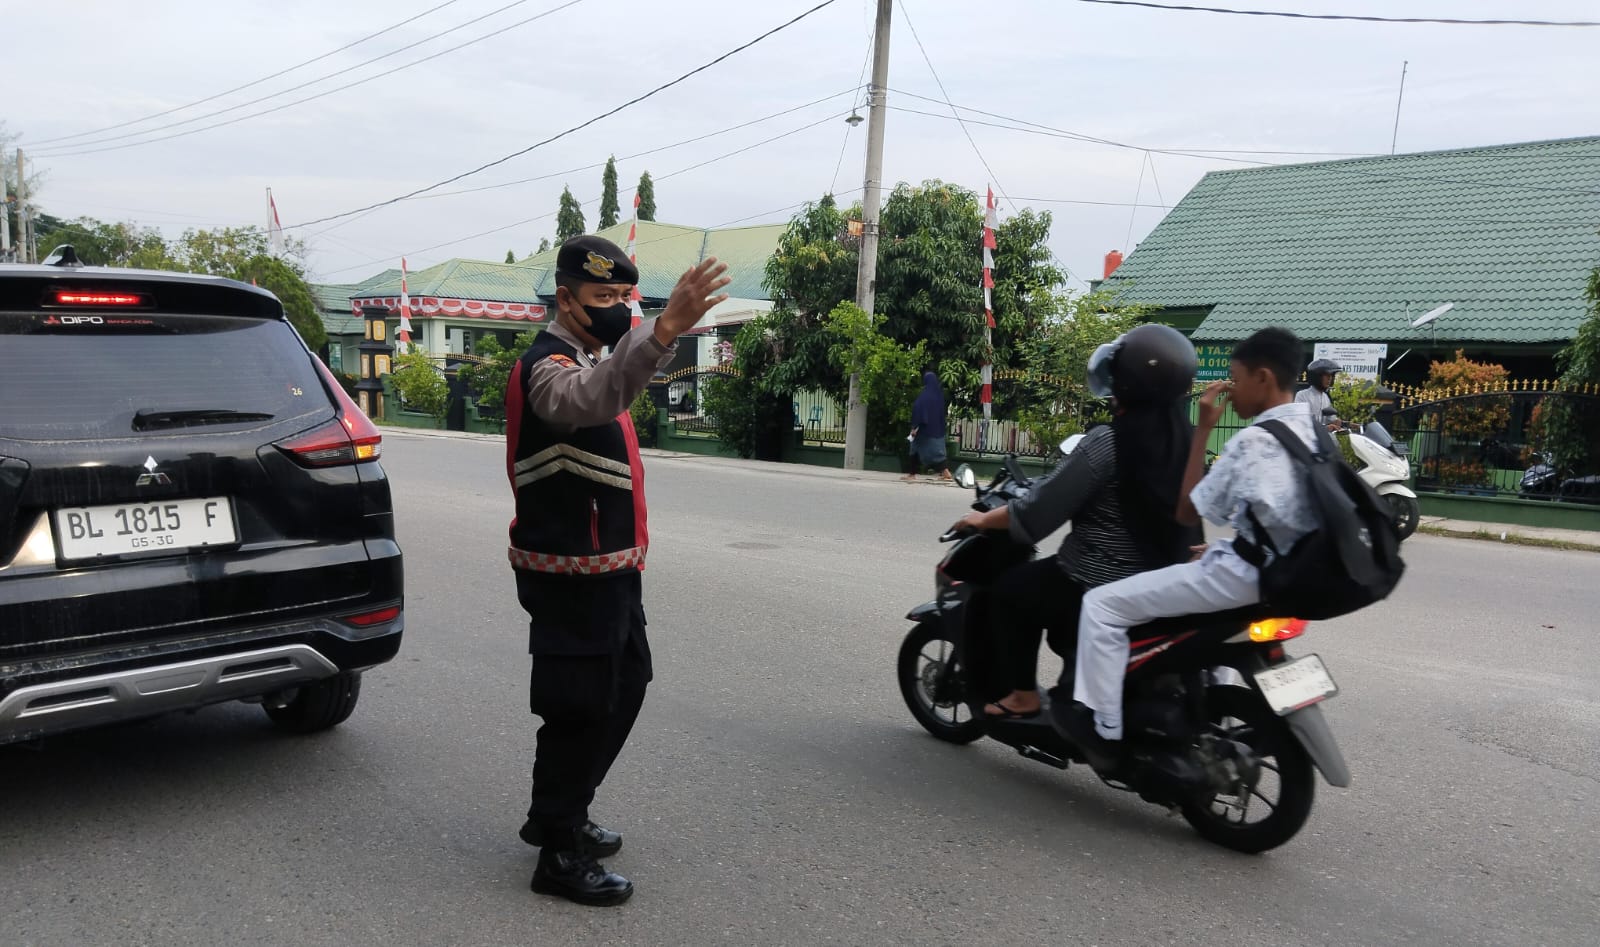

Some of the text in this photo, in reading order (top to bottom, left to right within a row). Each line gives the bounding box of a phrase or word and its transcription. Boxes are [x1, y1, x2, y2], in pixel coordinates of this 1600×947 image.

[61, 316, 104, 324] DIPO
[66, 502, 217, 540] BL 1815 F
